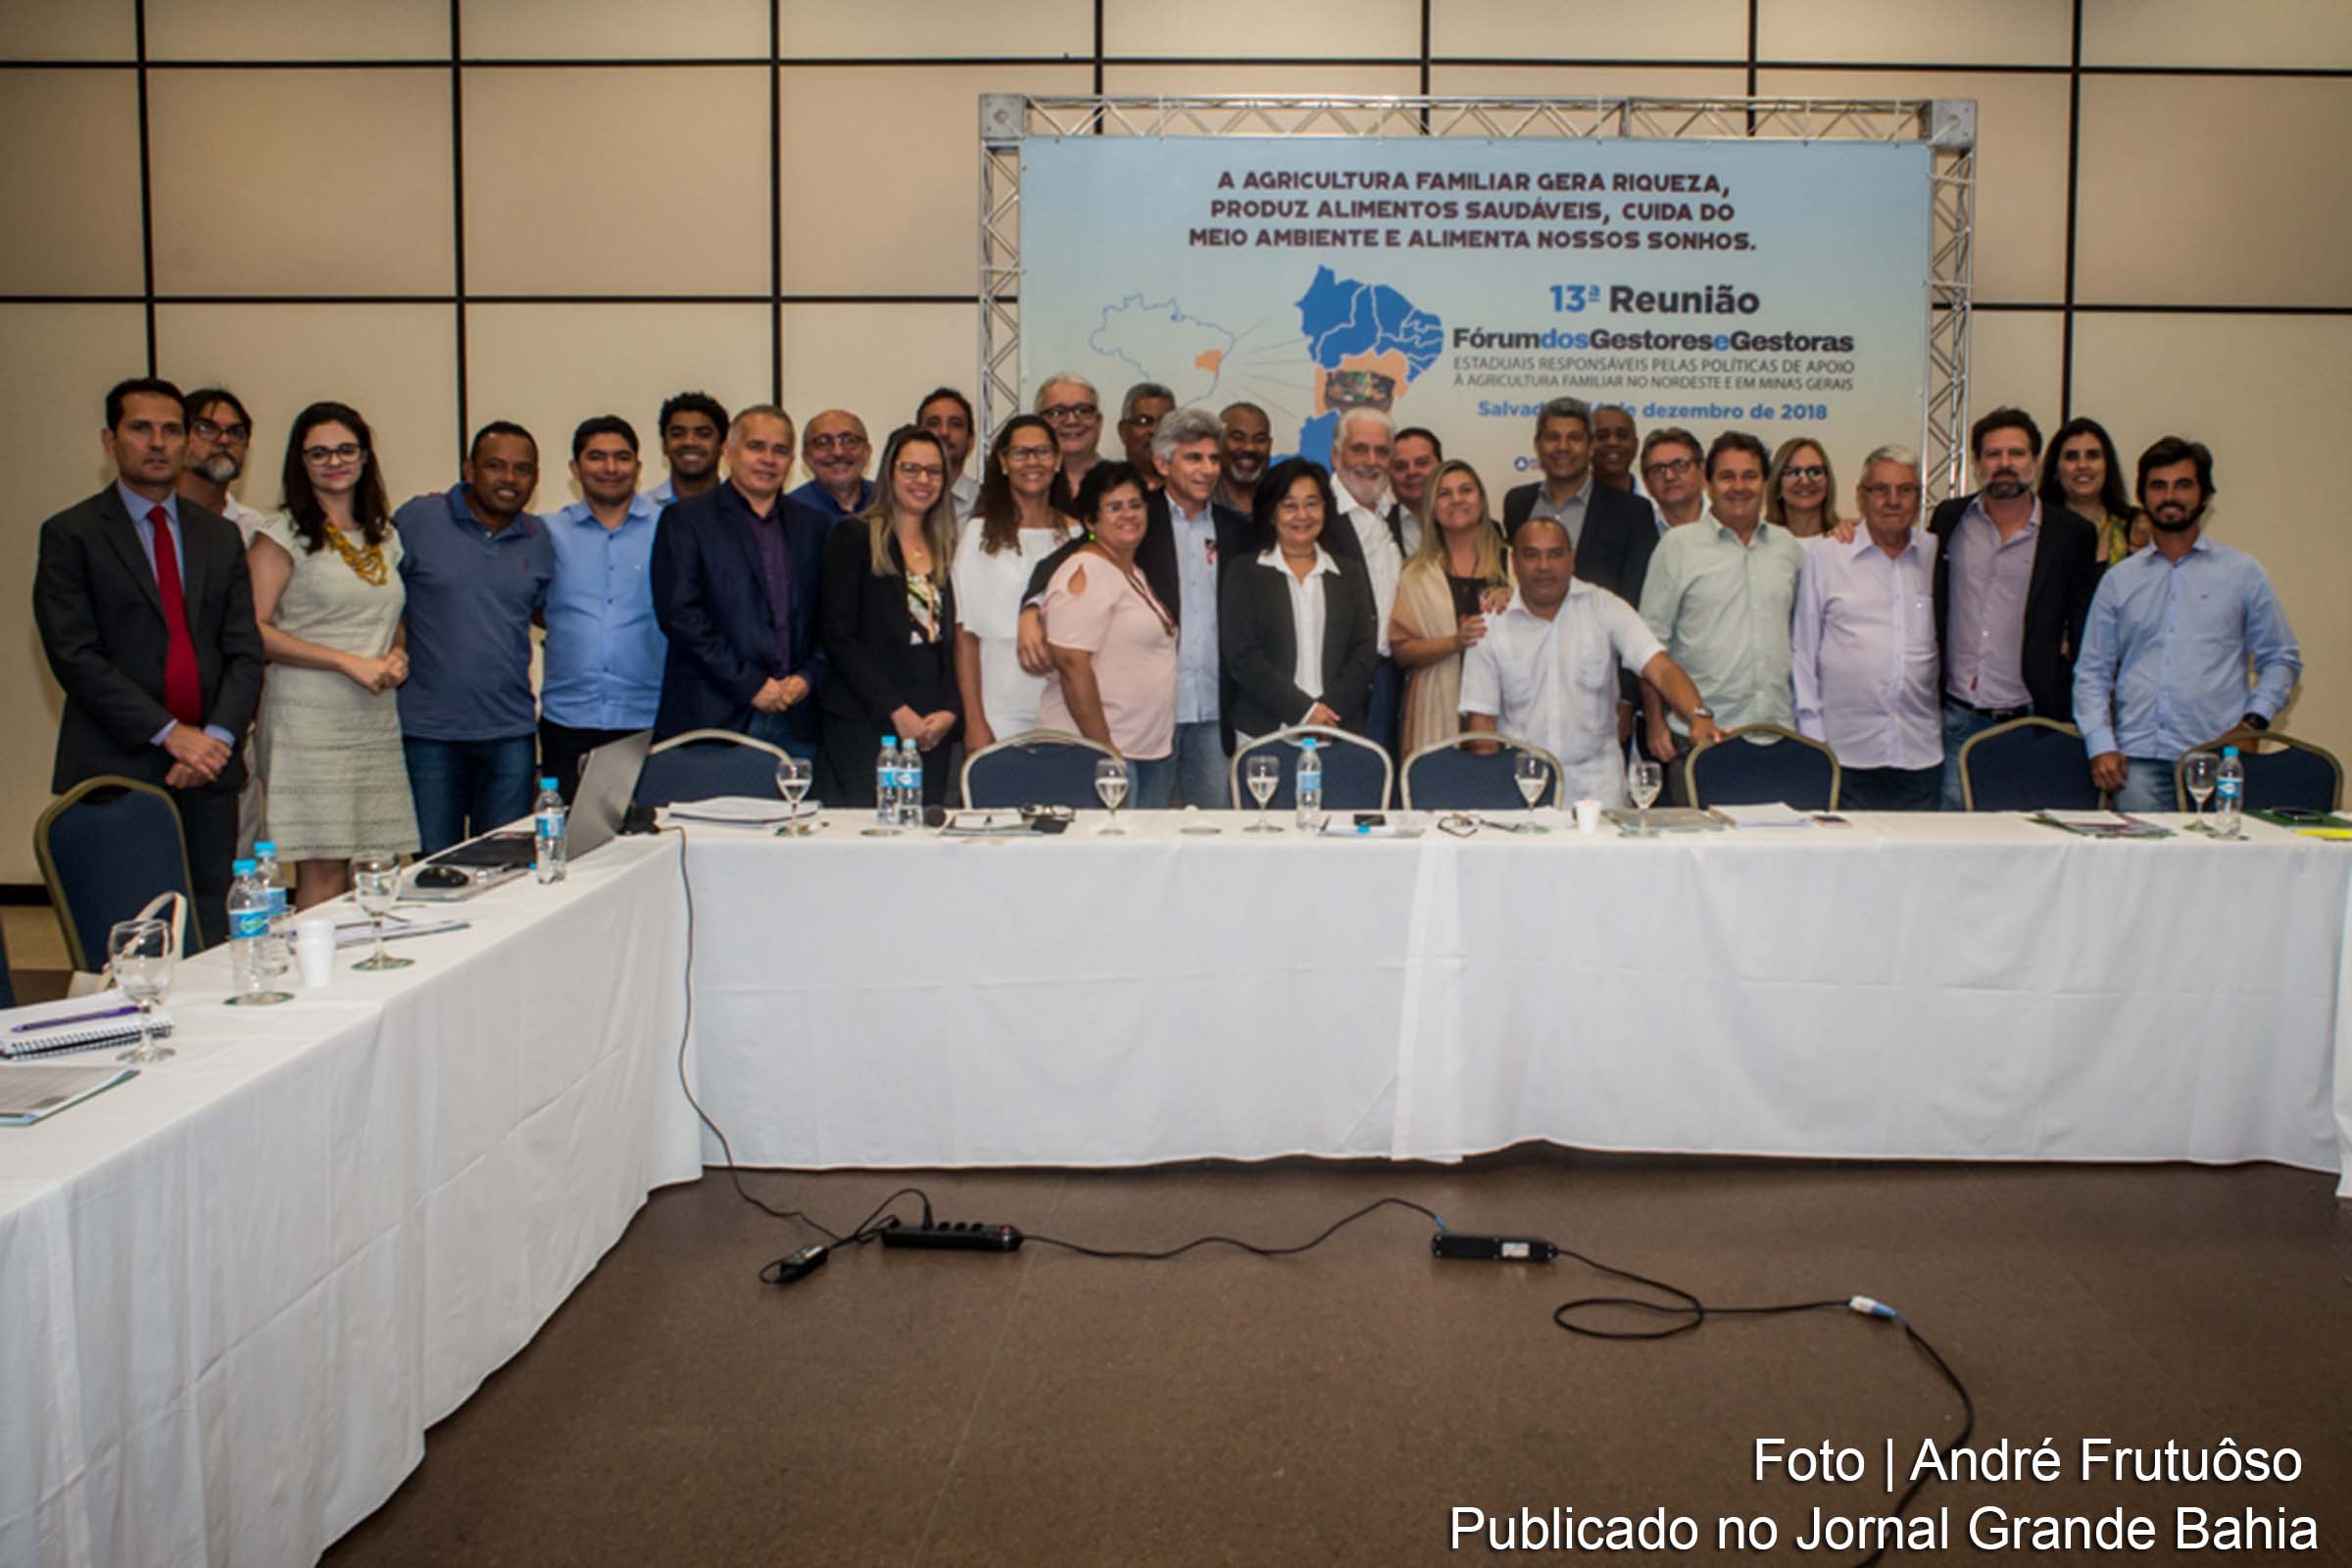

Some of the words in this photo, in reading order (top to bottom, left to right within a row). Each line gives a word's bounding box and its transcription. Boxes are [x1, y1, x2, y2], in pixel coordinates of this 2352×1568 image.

[1218, 172, 1235, 189] A
[1243, 172, 1409, 189] AGRICULTURA
[1416, 172, 1530, 190] FAMILIAR
[1538, 173, 1605, 191] GERA
[1612, 173, 1730, 198] RIQUEZA,
[1210, 200, 1308, 218] PRODUZ
[1316, 200, 1458, 219] ALIMENTOS
[1465, 198, 1610, 225] SAUDÁVEIS,
[1622, 203, 1692, 220] CUIDA
[1700, 204, 1735, 221] DO
[1189, 228, 1248, 246] MEIO
[1255, 228, 1378, 247] AMBIENTE
[1385, 229, 1400, 247] E
[1408, 229, 1530, 249] ALIMENTA
[1538, 230, 1641, 249] NOSSOS
[1647, 231, 1757, 250] SONHOS.
[1548, 284, 1600, 313] 13ª
[1609, 284, 1760, 315] Reunião
[1453, 356, 1535, 370] ESTADUAIS
[1539, 355, 1647, 371] RESPONSÁVEIS
[1651, 359, 1697, 372] PELAS
[1701, 357, 1777, 373] POLÍTICAS
[1783, 360, 1801, 373] DE
[1806, 360, 1855, 373] APOIO
[1466, 374, 1559, 387] AGRICULTURA
[1562, 374, 1623, 388] FAMILIAR
[1627, 375, 1647, 389] NO
[1651, 376, 1720, 389] NORDESTE
[1724, 376, 1733, 389] E
[1736, 376, 1755, 389] EM
[1759, 376, 1802, 390] MINAS
[1806, 377, 1853, 390] GERAIS
[1478, 401, 1544, 416] Salvad
[1642, 402, 1743, 419] dezembro
[1750, 403, 1774, 419] de
[1781, 403, 1828, 420] 2018
